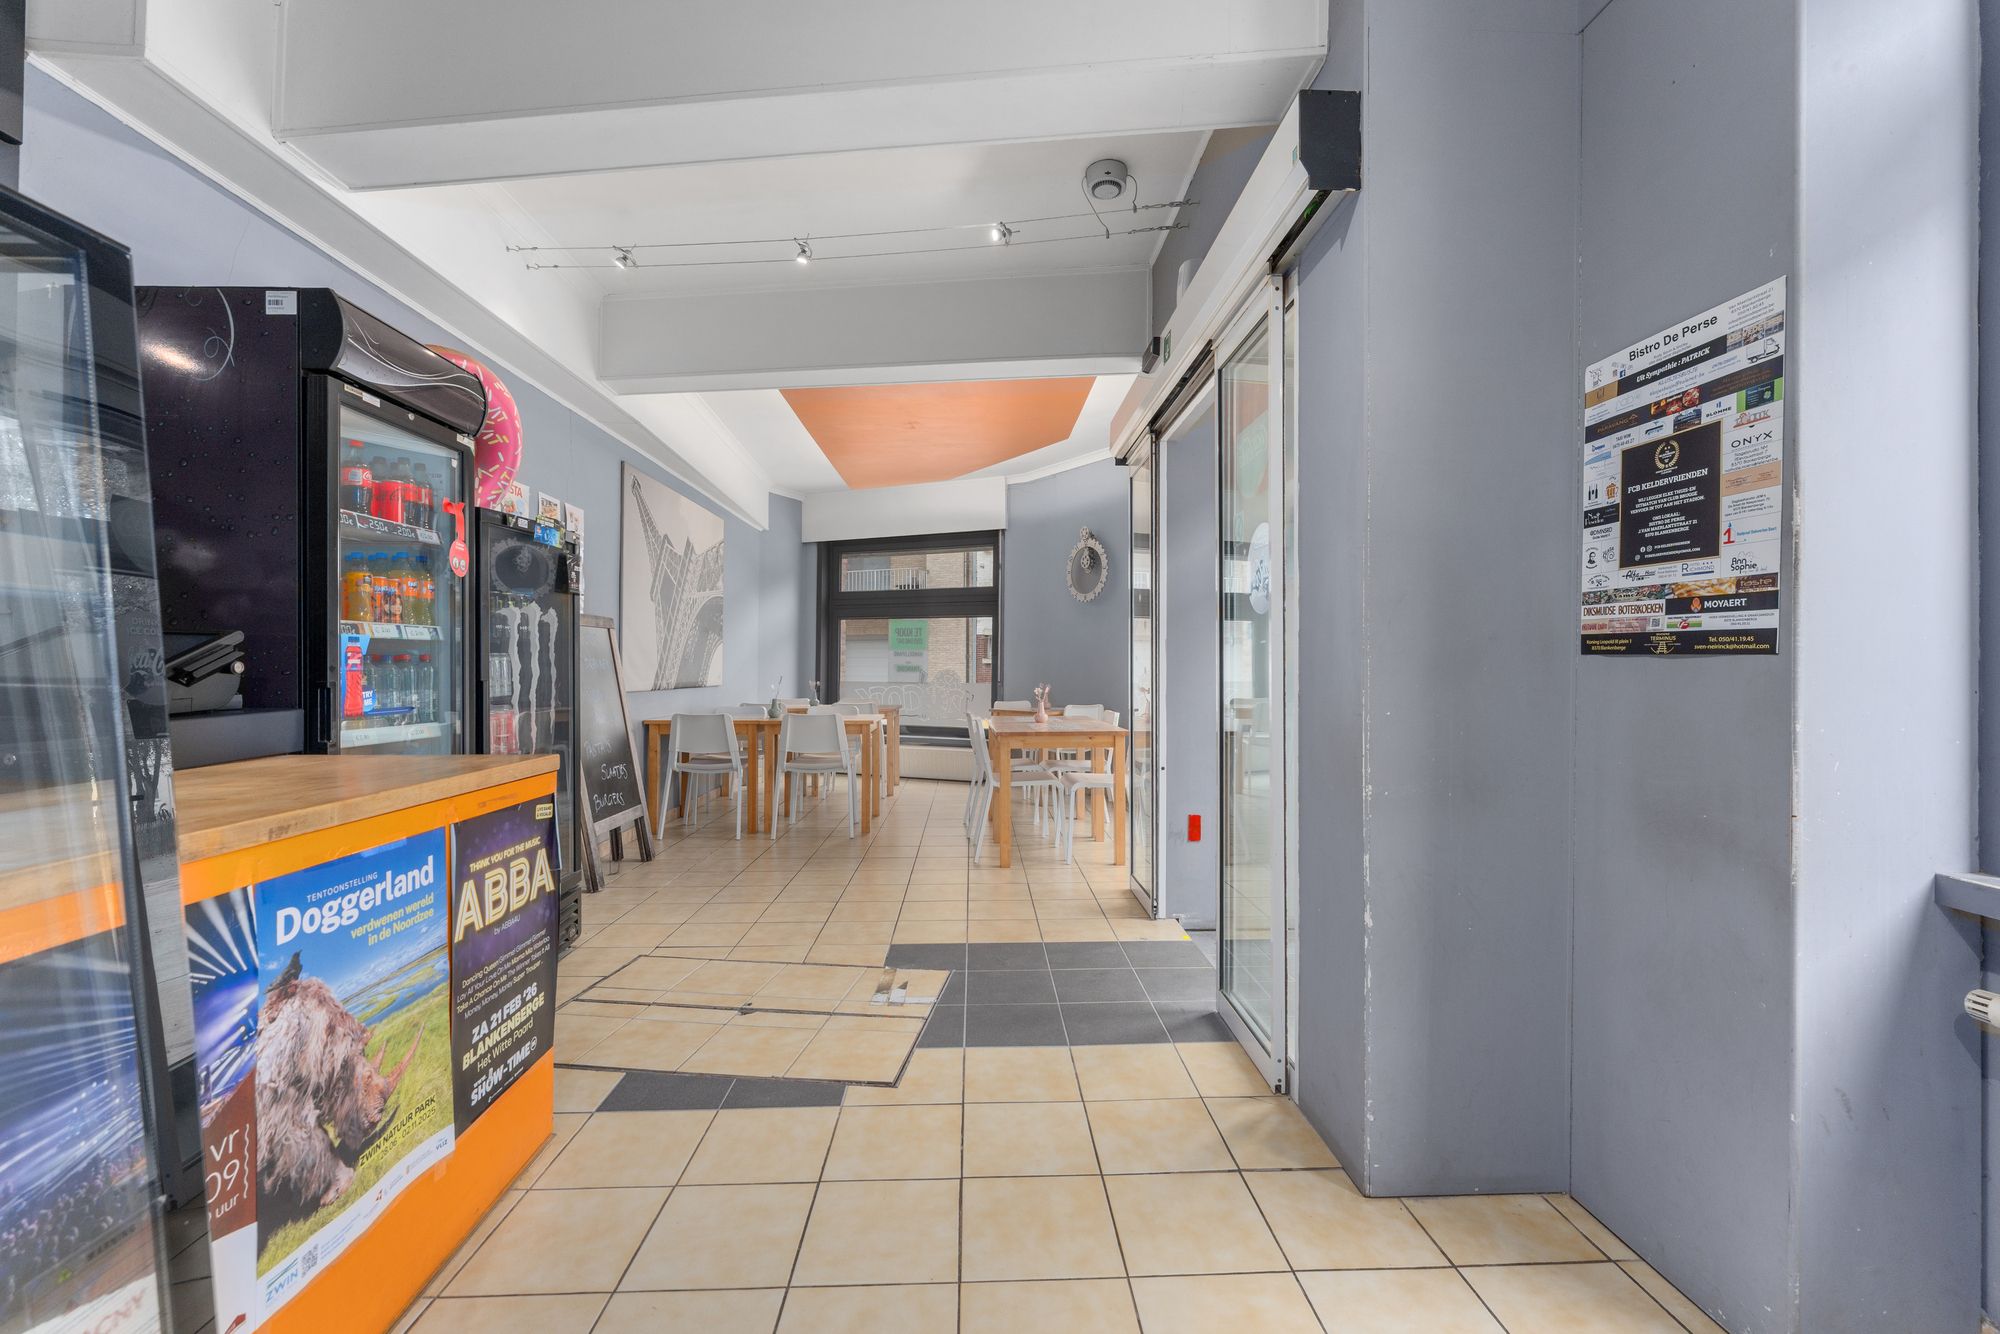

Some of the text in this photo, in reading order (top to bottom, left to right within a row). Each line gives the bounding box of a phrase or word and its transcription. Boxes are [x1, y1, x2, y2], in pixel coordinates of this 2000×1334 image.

[1629, 341, 1660, 361] Bistro
[1663, 333, 1678, 345] De
[1682, 316, 1717, 337] Perse
[1645, 361, 1677, 379] Sympathie
[1681, 346, 1710, 364] PATRICK
[1705, 406, 1731, 417] BLOMME
[1730, 430, 1772, 448] ONYX
[1627, 484, 1640, 493] FCB
[1641, 467, 1708, 490] KELDERVRIENDEN
[1679, 490, 1697, 498] BRUGGE
[1650, 520, 1692, 531] MAERLANTSTRAAT
[1654, 526, 1689, 536] BLANKENBERGE
[1730, 560, 1757, 574] Sophie
[1731, 557, 1746, 565] Ann
[1583, 602, 1663, 616] DIKSMUIDSE BOTERKOEKEN
[1704, 598, 1747, 608] MOYAERT
[362, 690, 373, 698] TRY
[593, 792, 625, 813] BURGERS
[470, 836, 541, 873] THANK YOU FOR THE MUSIC
[276, 854, 434, 946] Doggerland
[306, 872, 378, 903] TENTOONSTELLING
[454, 847, 556, 944] ABBA
[351, 892, 434, 939] verdwenen wereld
[368, 908, 434, 946] in de Noordzee
[494, 915, 521, 936] by ABBA4U
[457, 993, 467, 1003] Lay
[474, 980, 485, 990] Your
[485, 973, 497, 983] Love
[503, 962, 511, 971] Me
[512, 953, 525, 966] Mama
[533, 936, 550, 951] Waterloo
[462, 968, 483, 989] Dancing
[484, 960, 499, 974] Queen
[513, 971, 525, 984] Super
[525, 960, 540, 974] Trouper
[457, 1002, 469, 1014] Take
[474, 985, 492, 1001] Chance
[493, 980, 500, 988] On
[500, 974, 507, 983] Me
[516, 959, 530, 971] Winner
[472, 982, 537, 1044] ZA 21 FEB '26
[462, 991, 545, 1071] BLANKENBERGE
[477, 1056, 492, 1072] Het
[492, 1038, 512, 1059] Witte
[513, 1016, 534, 1042] Paard
[470, 1040, 531, 1106] SHOW-TIME
[210, 1128, 240, 1162] vr
[360, 1144, 381, 1167] ZWIN
[382, 1112, 413, 1146] NATUUR
[415, 1094, 436, 1118] PARK
[436, 1140, 448, 1150] VLIZ
[215, 1192, 240, 1218] uur
[265, 1268, 299, 1303] ZWIN
